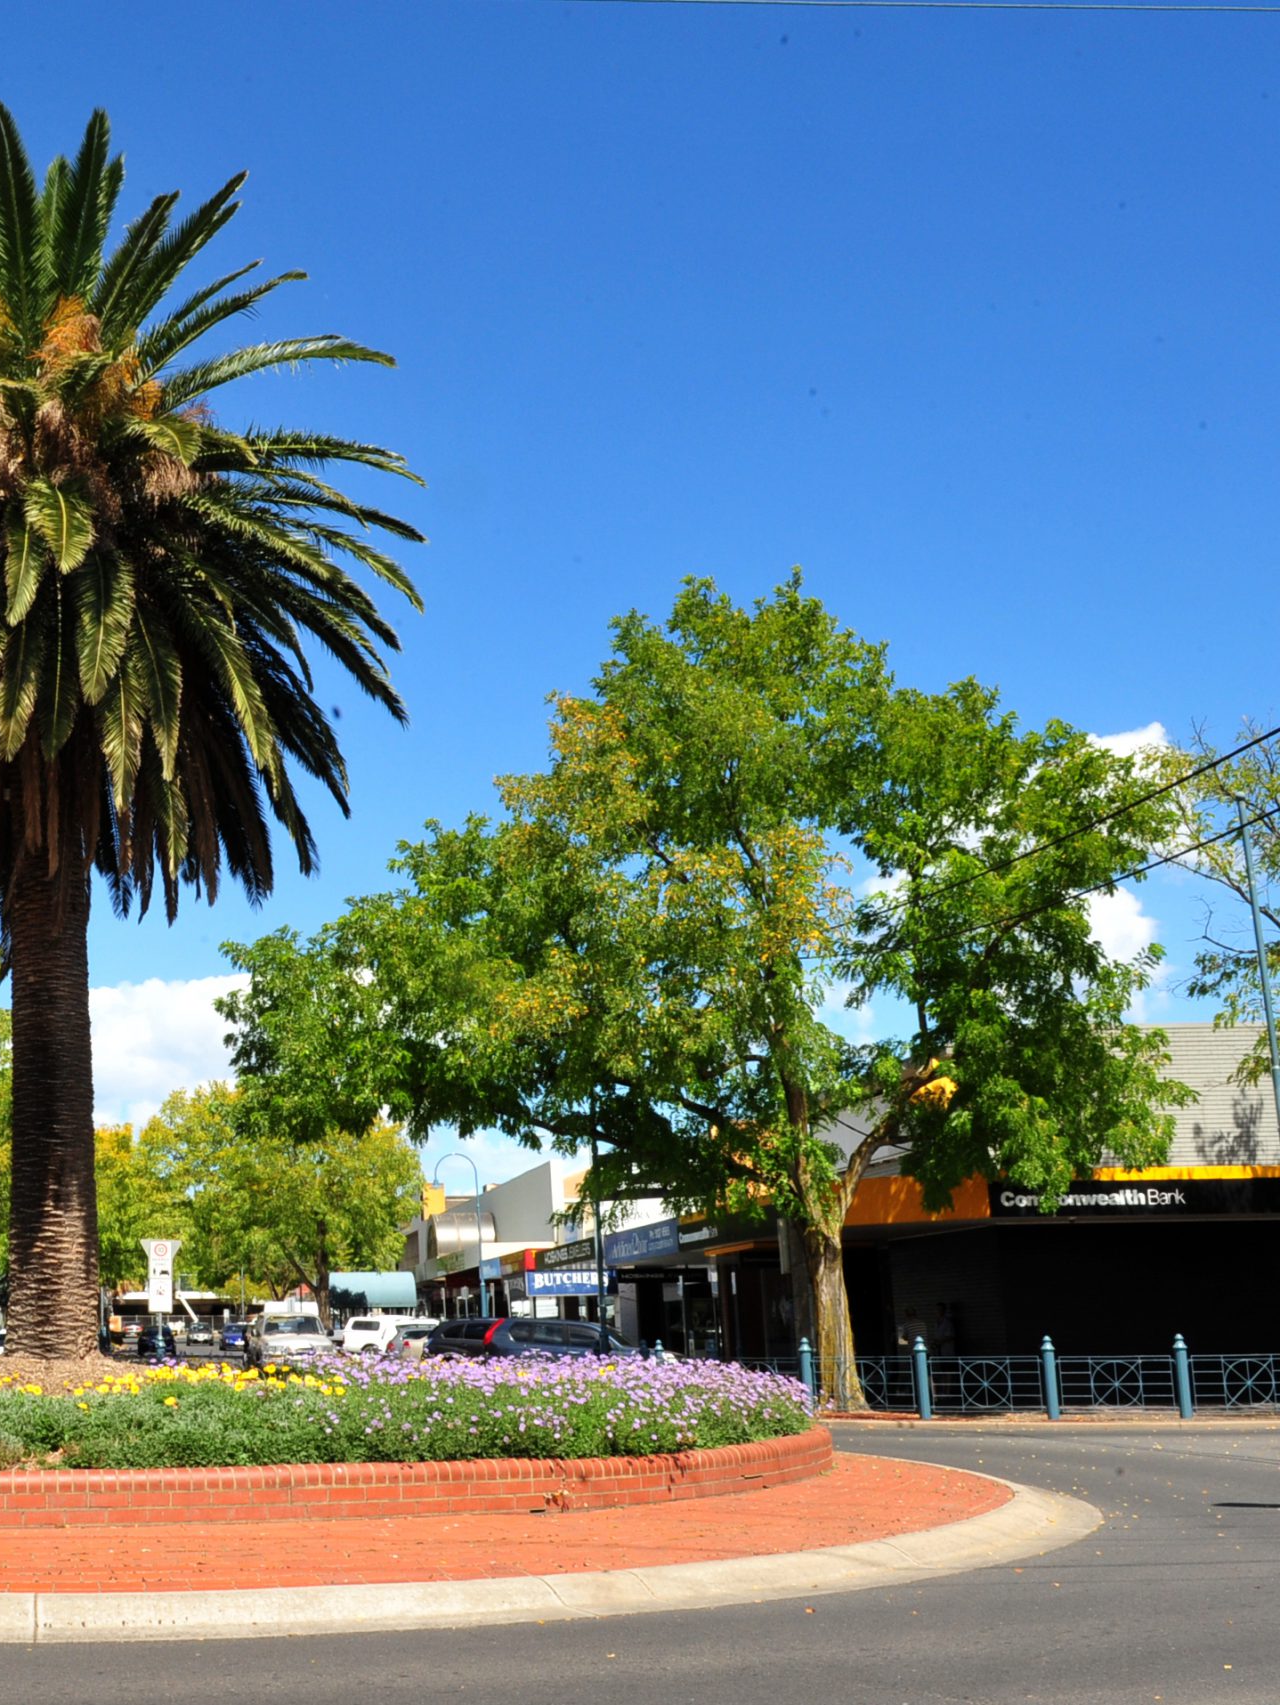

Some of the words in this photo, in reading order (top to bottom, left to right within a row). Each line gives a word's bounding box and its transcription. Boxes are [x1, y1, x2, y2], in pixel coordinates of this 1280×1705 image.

[1000, 1189, 1146, 1208] Comonwealth
[1147, 1188, 1187, 1205] Bank
[534, 1271, 609, 1290] BUTCHERS
